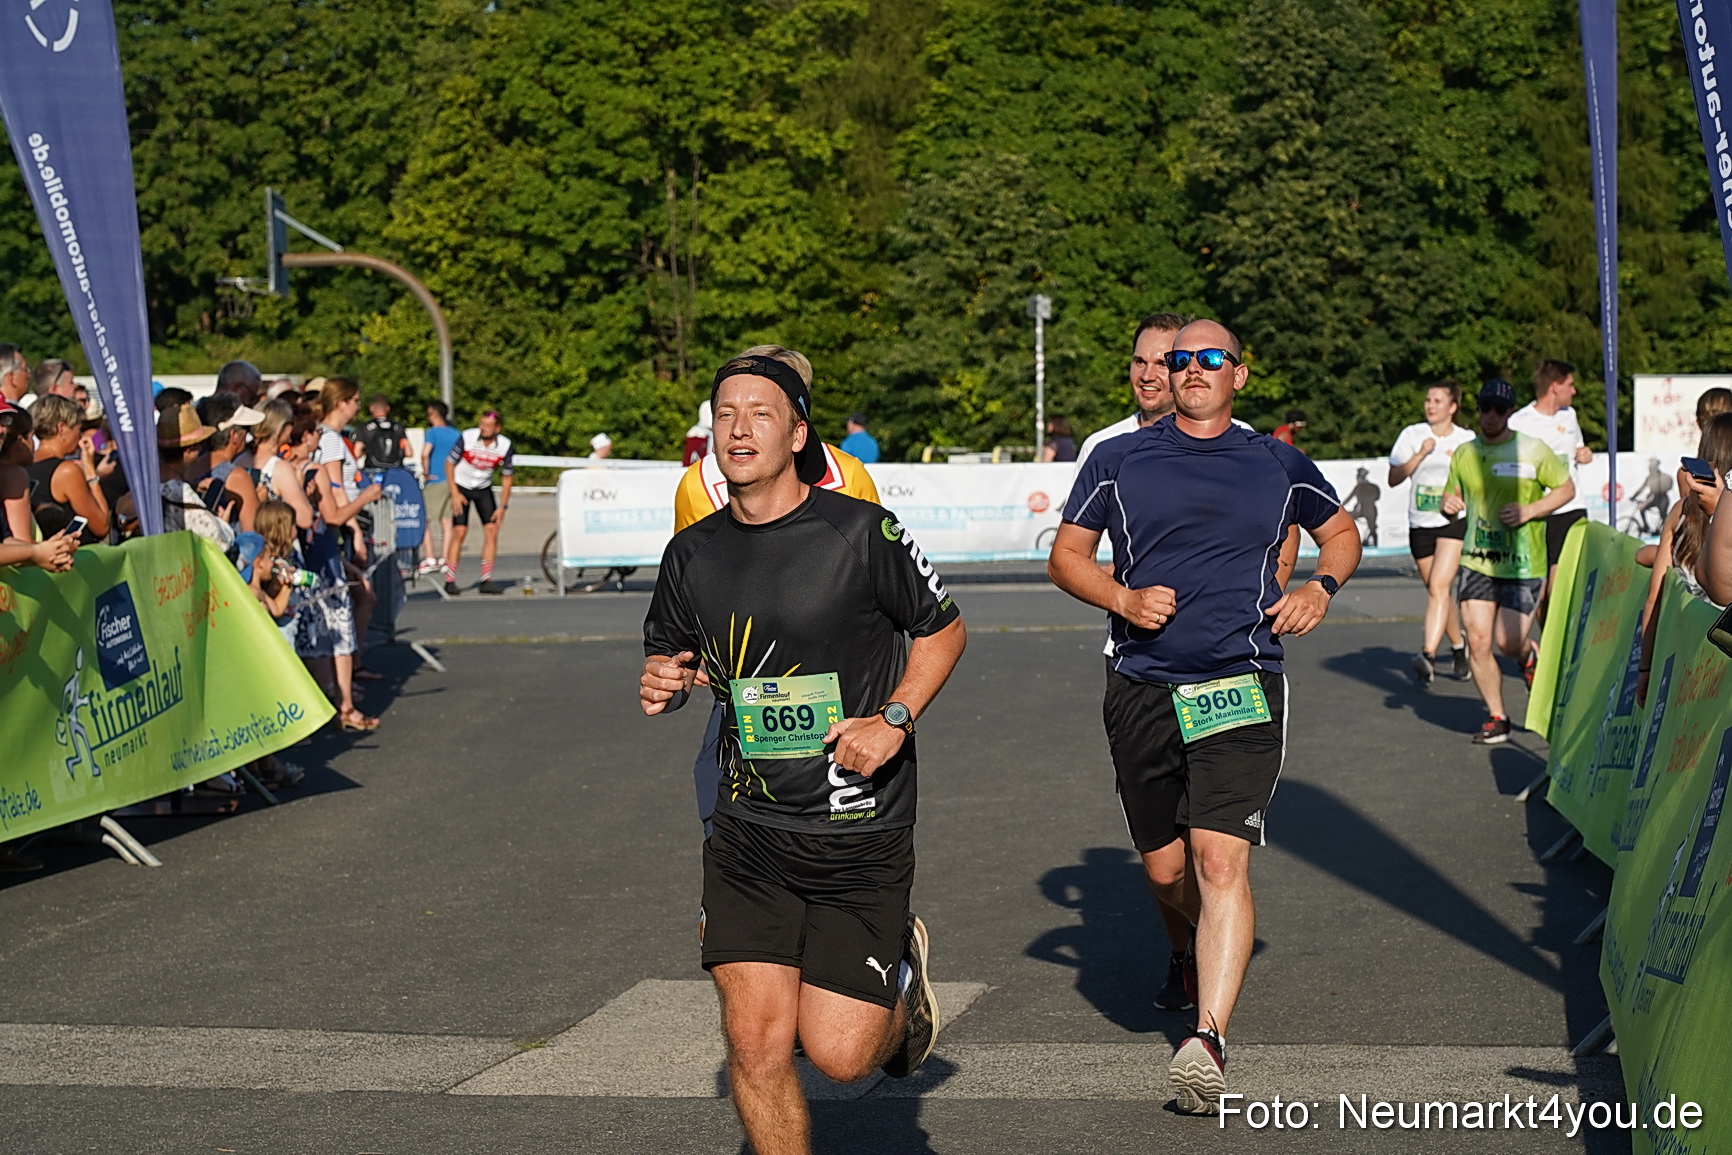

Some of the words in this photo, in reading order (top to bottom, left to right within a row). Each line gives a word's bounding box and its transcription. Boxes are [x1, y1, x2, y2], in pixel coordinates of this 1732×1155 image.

[98, 612, 133, 641] Fischer
[90, 646, 184, 746] firmenlauf
[1196, 688, 1243, 715] 960
[1250, 687, 1265, 715] 2022
[762, 705, 815, 732] 669
[827, 705, 839, 724] 22
[1181, 707, 1194, 730] RUN
[1193, 715, 1214, 728] Stork
[743, 715, 755, 743] RUN
[754, 734, 786, 744] Spenger
[104, 731, 149, 768] neumarkt
[830, 809, 876, 821] drinknow.de
